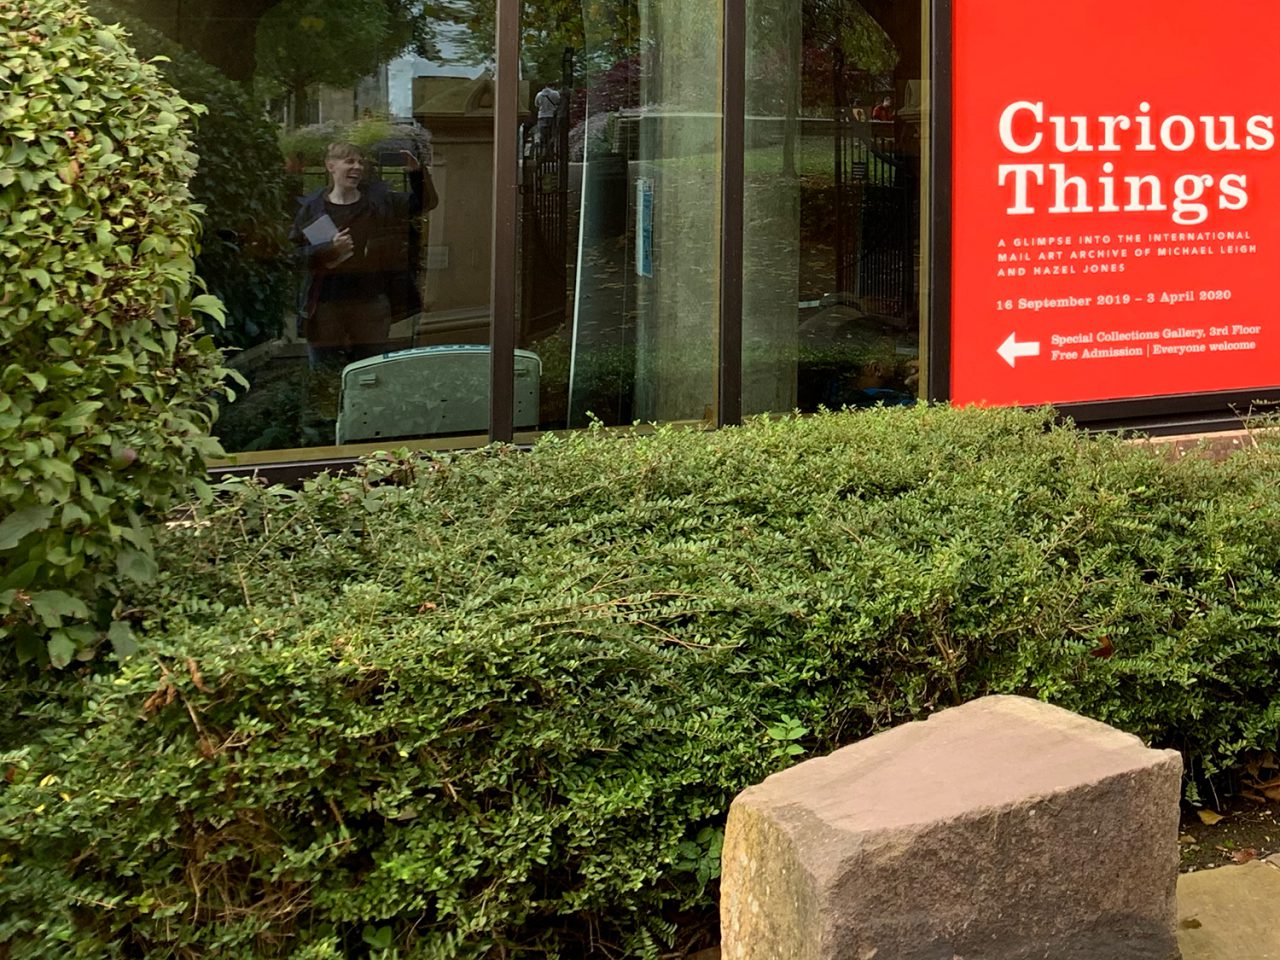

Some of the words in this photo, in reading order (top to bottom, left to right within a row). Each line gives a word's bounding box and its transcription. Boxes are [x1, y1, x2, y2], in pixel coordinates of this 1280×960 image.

[999, 100, 1275, 154] Curious
[998, 162, 1248, 225] Things
[997, 239, 1006, 247] A
[1013, 236, 1072, 247] GLIMPSE
[1079, 235, 1111, 245] INTO
[1118, 233, 1141, 243] THE
[1149, 231, 1251, 242] INTERNATIONAL
[998, 252, 1031, 262] MAIL
[1038, 251, 1063, 261] ART
[1070, 249, 1127, 259] ARCHIVE
[1134, 248, 1151, 258] OF
[1157, 246, 1214, 257] MICHAEL
[1220, 244, 1257, 254] LEIGH
[997, 267, 1026, 277] AND
[1033, 265, 1076, 276] HAZEL
[1083, 263, 1126, 274] JONES
[996, 299, 1013, 311] 16
[1018, 296, 1092, 311] September
[1097, 294, 1131, 306] 2019
[1147, 292, 1155, 304] 3
[1160, 290, 1194, 305] April
[1199, 289, 1232, 301] 2020
[1051, 332, 1094, 347] Special
[1096, 330, 1160, 343] Collections
[1162, 327, 1206, 340] Gallery,
[1209, 325, 1229, 337] 3rd
[1231, 324, 1262, 335] Floor
[1051, 350, 1078, 361] Free
[1081, 346, 1143, 359] Admission
[1152, 343, 1206, 356] Everyone
[1209, 340, 1256, 352] welcome
